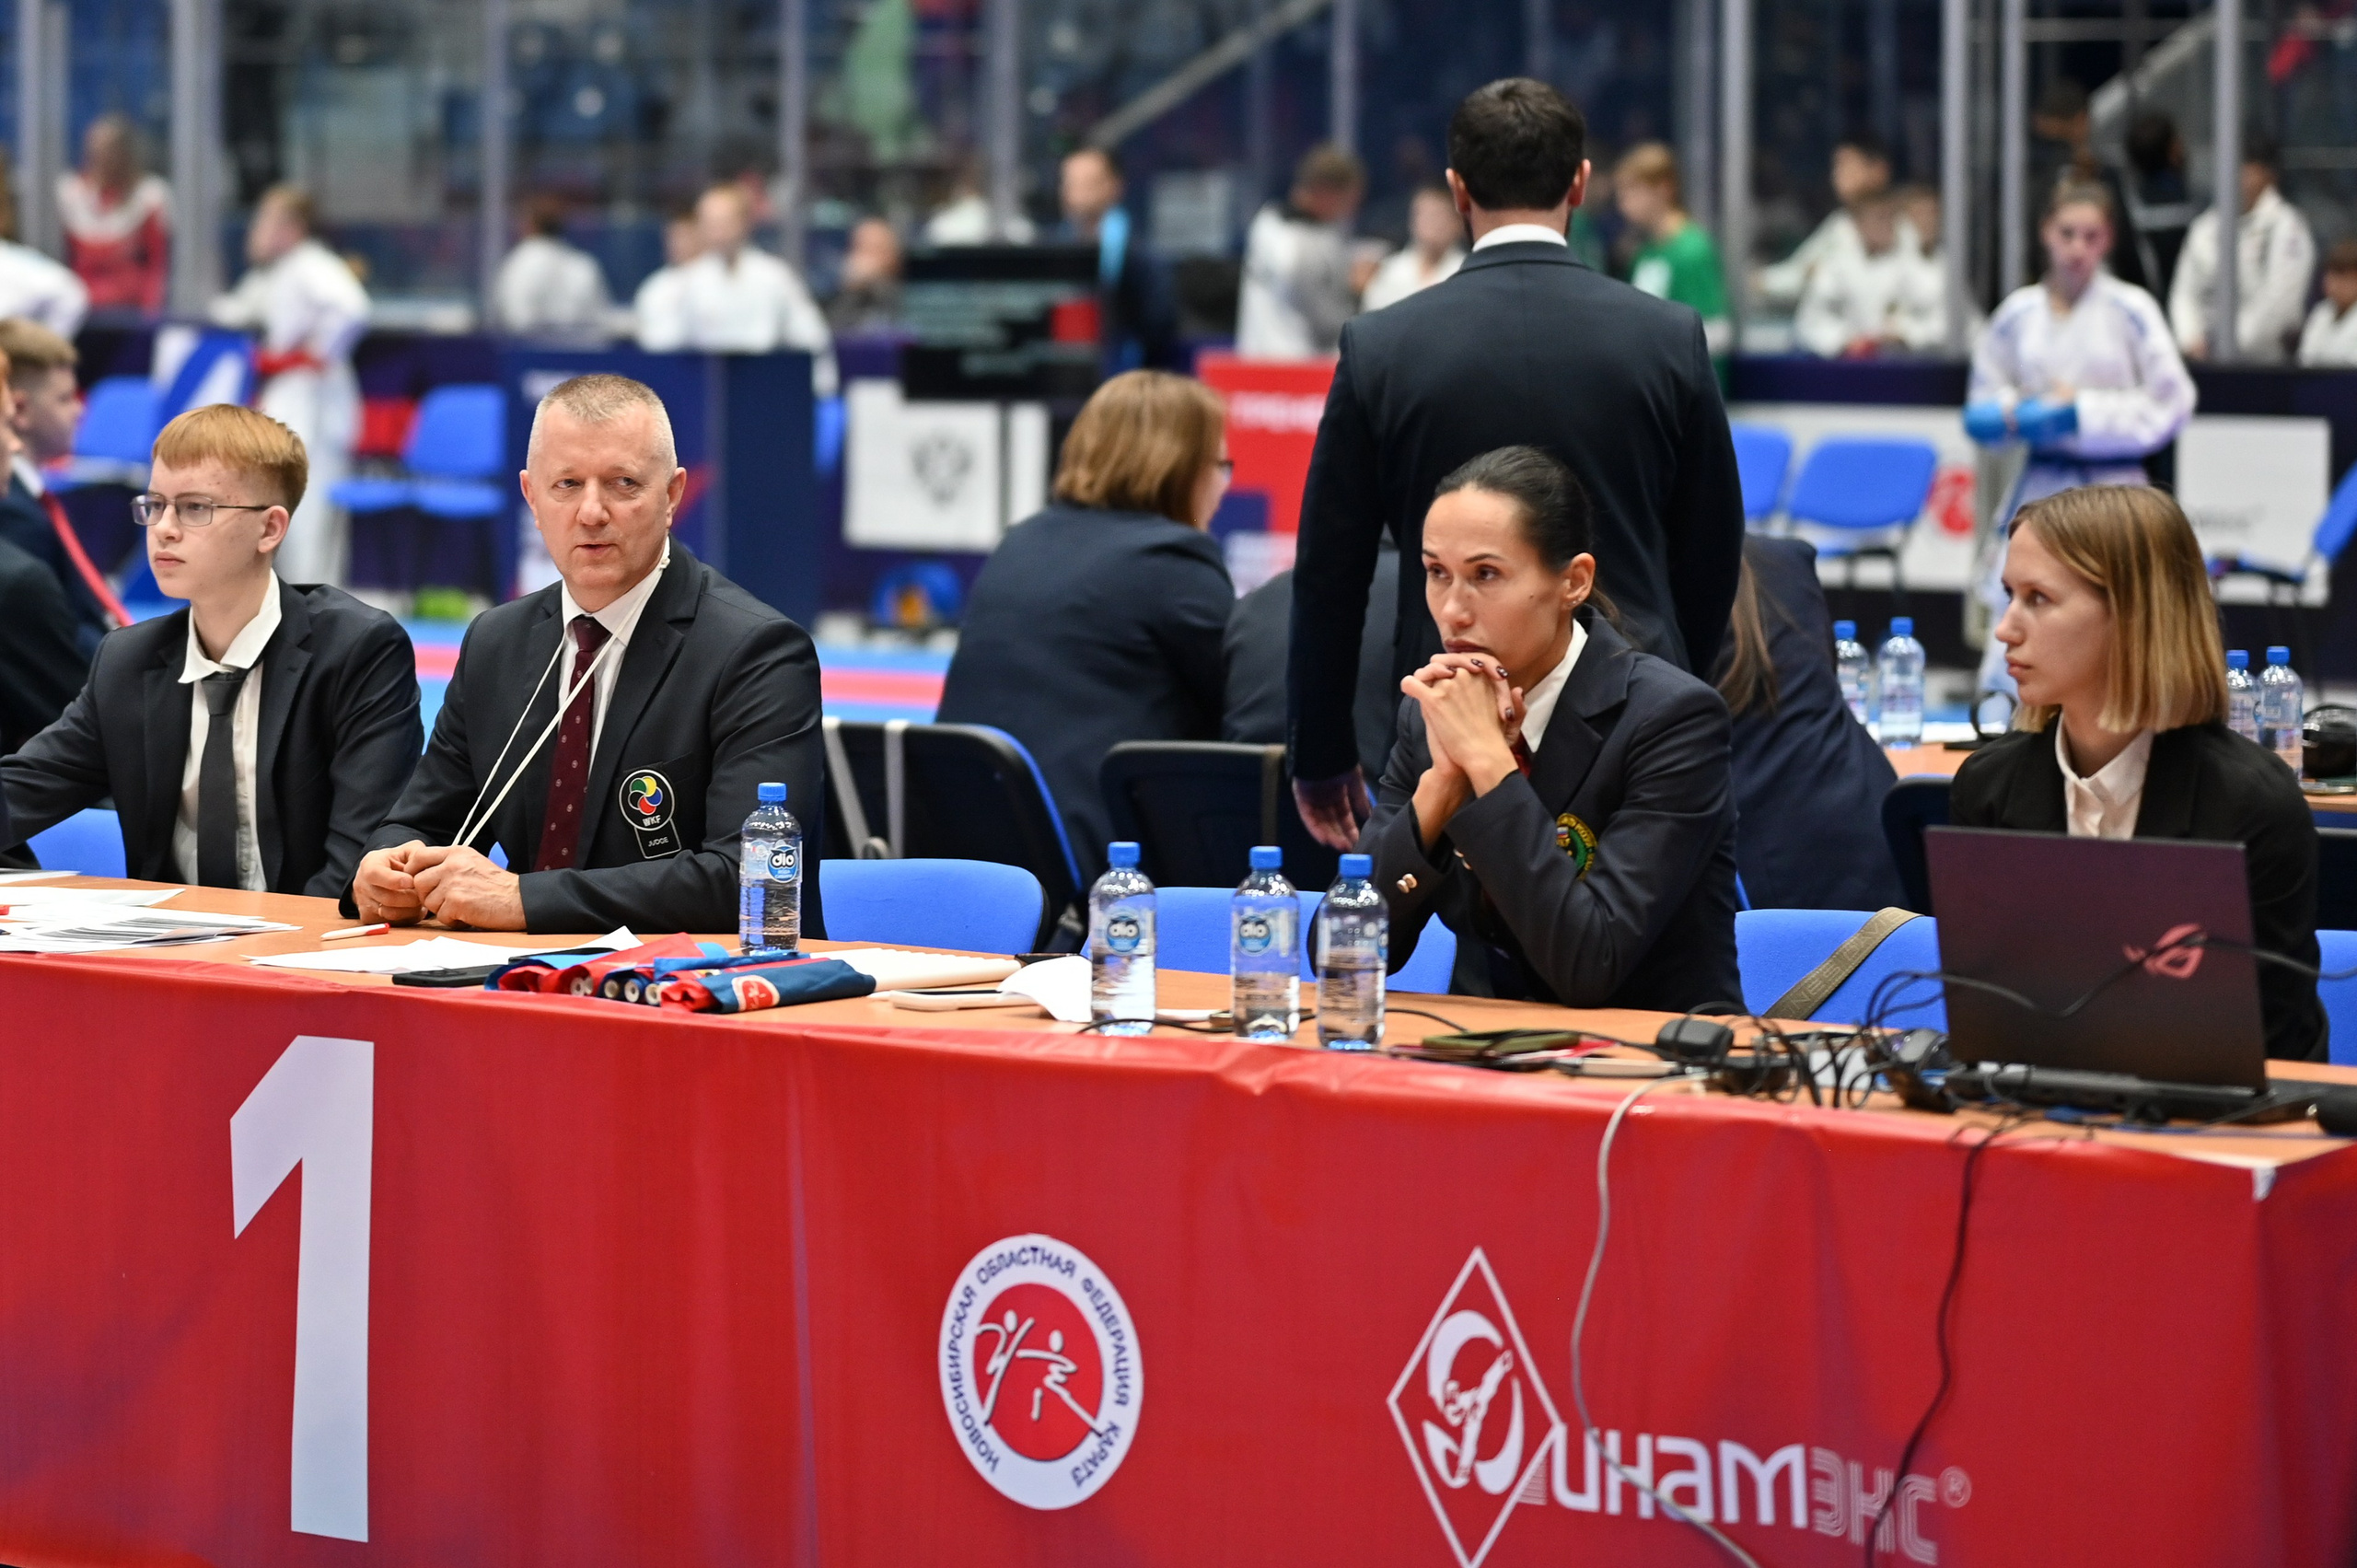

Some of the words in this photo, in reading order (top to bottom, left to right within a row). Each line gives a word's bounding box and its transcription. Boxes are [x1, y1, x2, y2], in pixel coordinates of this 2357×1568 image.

[642, 815, 661, 827] WKF
[649, 837, 668, 847] JUDGE
[772, 854, 795, 866] dio
[229, 1035, 374, 1543] 1
[977, 1246, 1076, 1284] ОБЛАСТНАЯ
[1081, 1277, 1131, 1408] ФЕДЕРАЦИЯ
[946, 1284, 1001, 1473] НОВОСИБИРСКАЯ
[1070, 1420, 1122, 1489] КАРАТЭ
